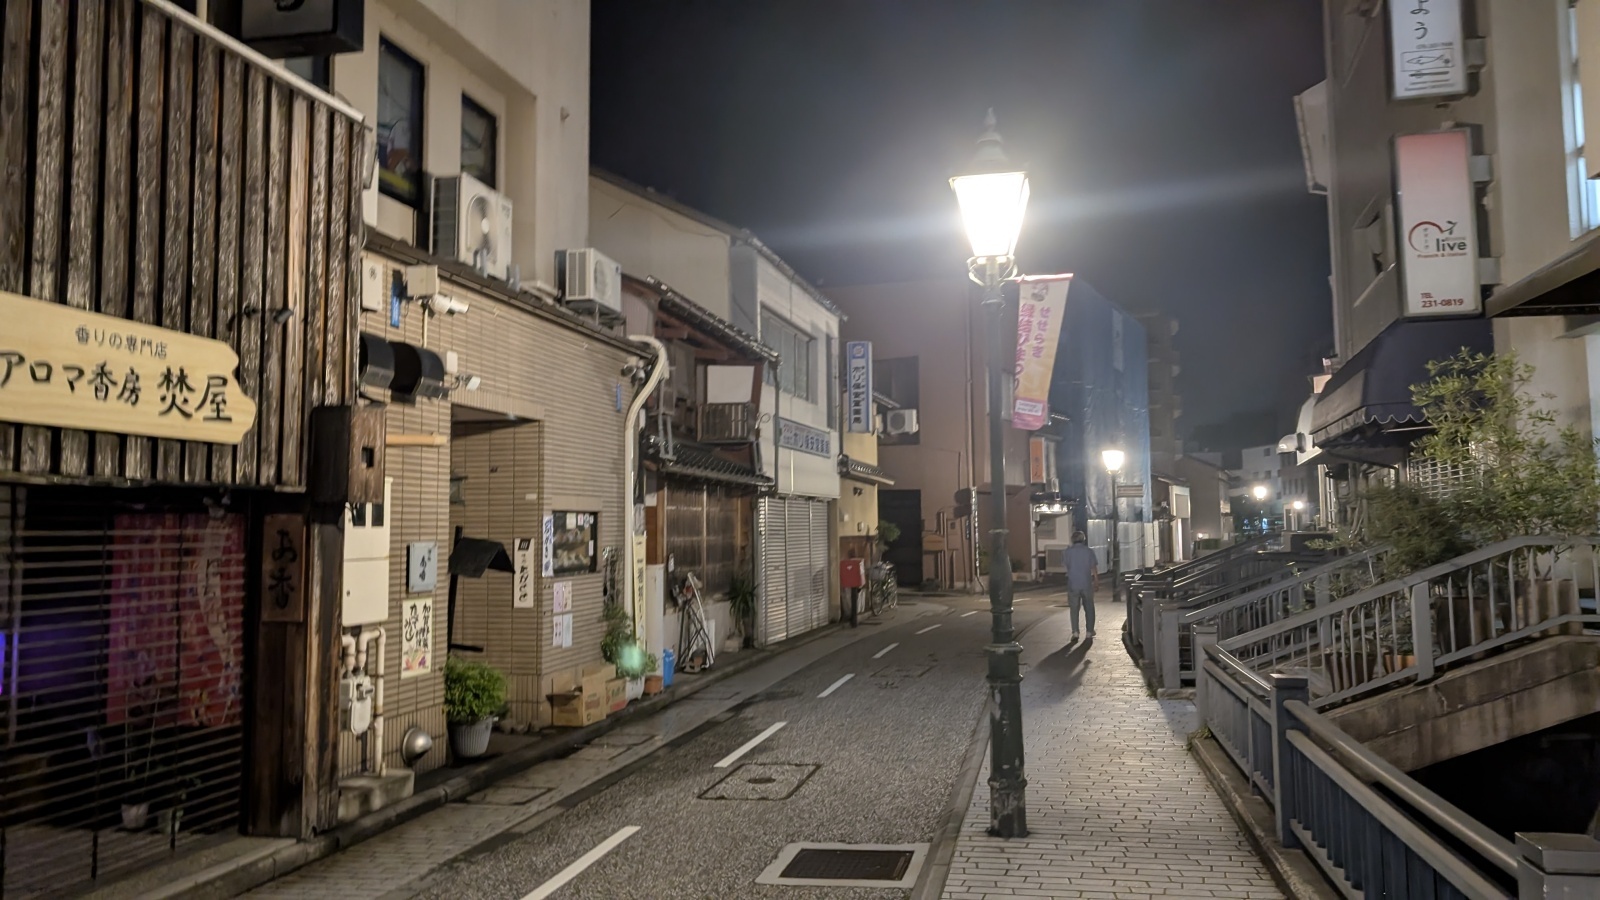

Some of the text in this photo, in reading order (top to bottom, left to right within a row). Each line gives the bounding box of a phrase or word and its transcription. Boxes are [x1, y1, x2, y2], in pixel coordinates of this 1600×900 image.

[1421, 298, 1464, 308] 231-0819
[75, 323, 168, 360] 香りの専門店
[0, 349, 233, 423] アロマ香房 焚屋
